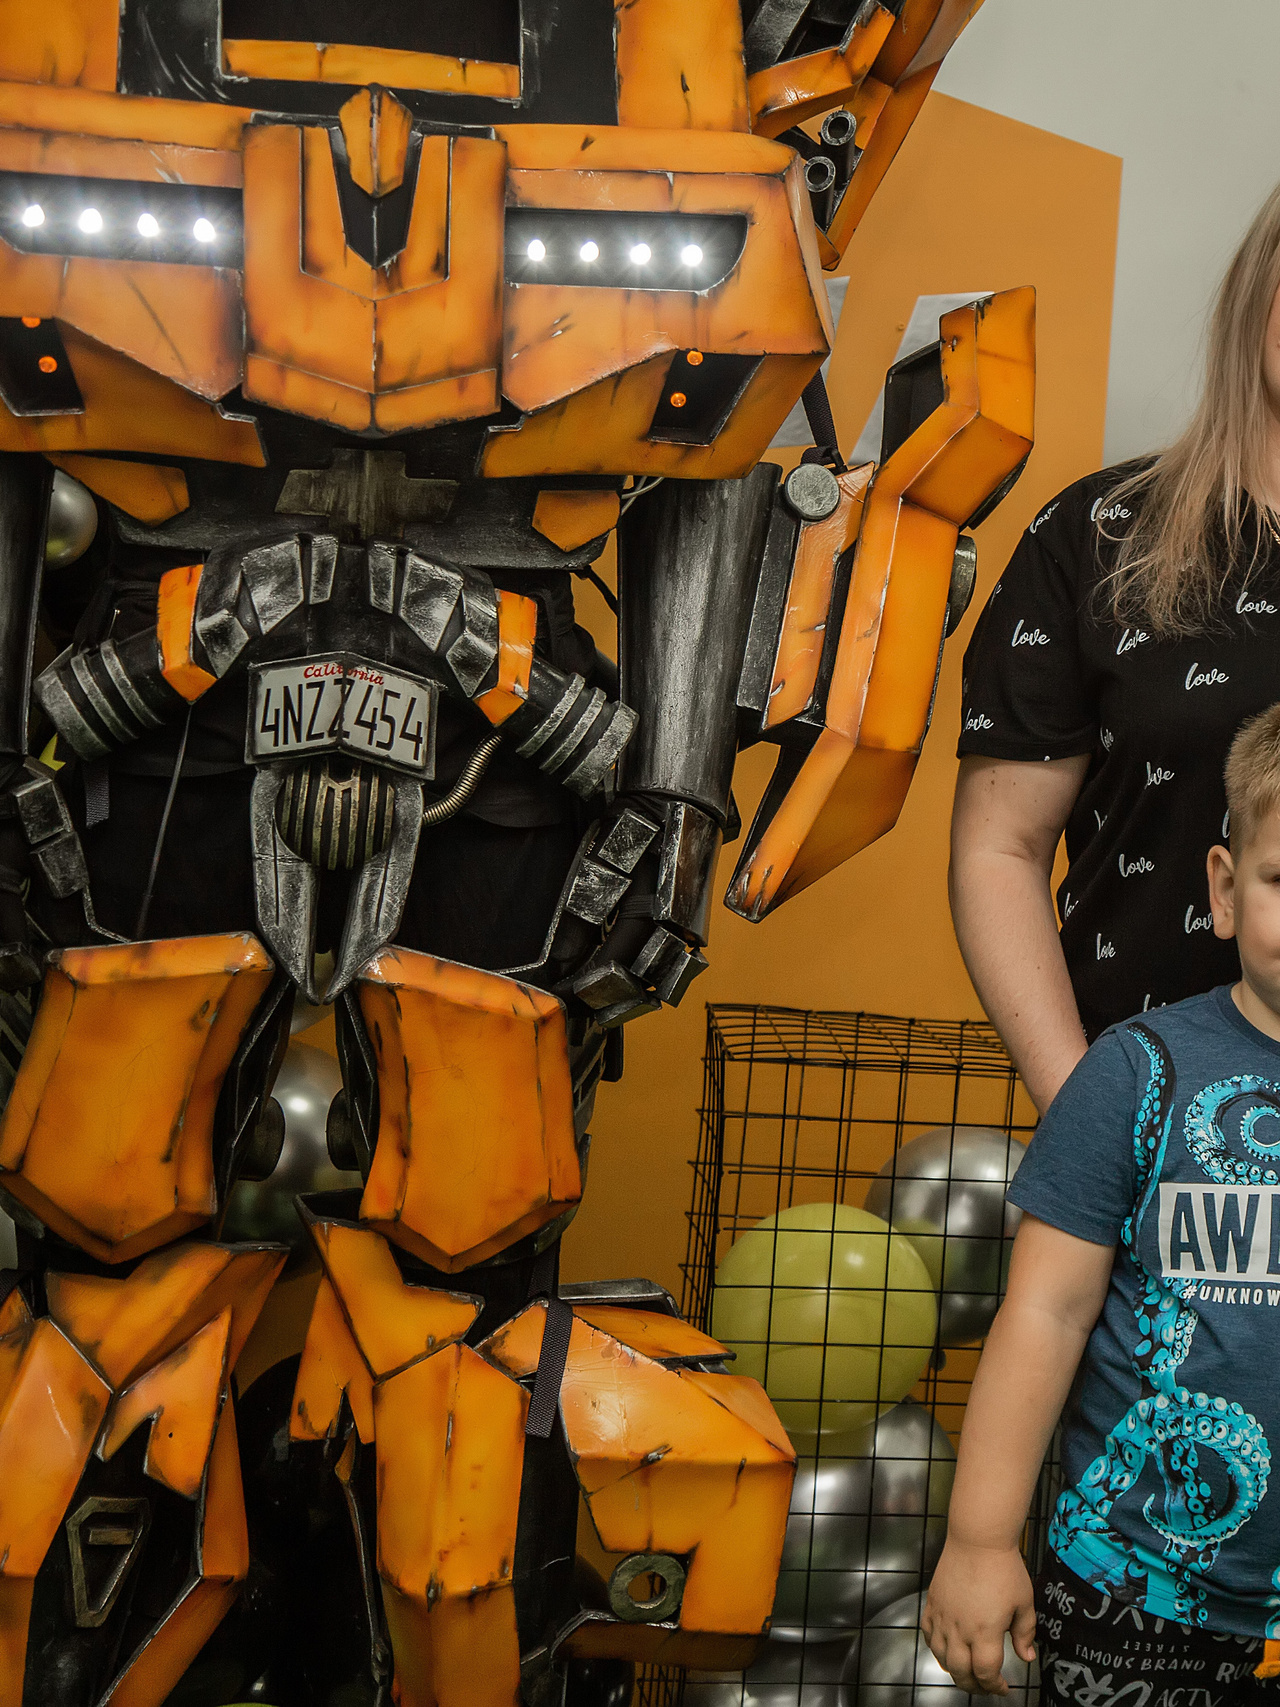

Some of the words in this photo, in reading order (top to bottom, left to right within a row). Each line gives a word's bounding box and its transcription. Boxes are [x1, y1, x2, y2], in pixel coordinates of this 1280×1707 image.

[1236, 592, 1278, 614] love
[1011, 619, 1050, 648] love
[1184, 662, 1230, 690] love
[260, 678, 423, 761] 4NZZ454
[1118, 853, 1154, 878] love
[1184, 904, 1215, 934] lov
[1036, 1610, 1063, 1640] Bra
[1075, 1644, 1136, 1669] FAMOUS
[1140, 1658, 1206, 1671] BRAND
[1122, 1640, 1190, 1654] STREET
